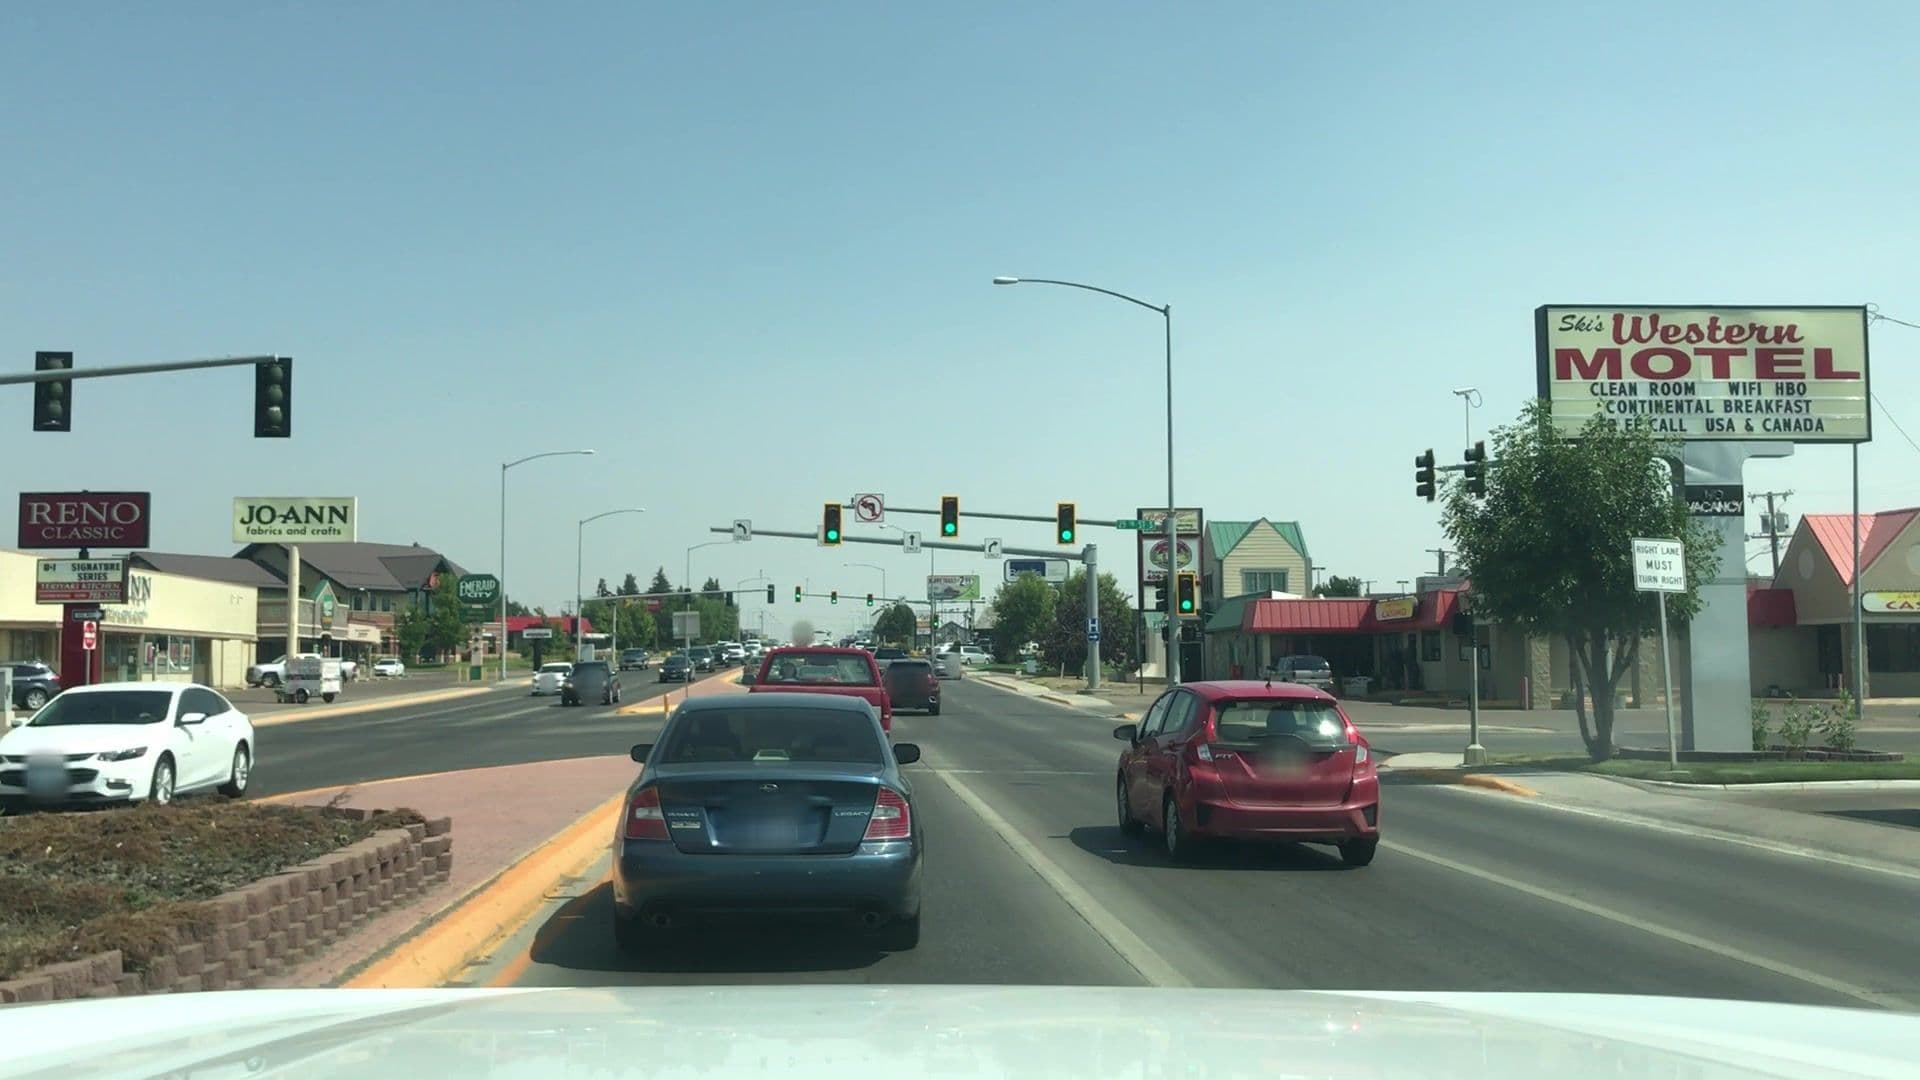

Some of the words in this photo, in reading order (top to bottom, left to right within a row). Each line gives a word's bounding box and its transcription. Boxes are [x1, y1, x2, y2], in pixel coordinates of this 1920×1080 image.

[1558, 314, 1604, 332] Ski's
[1612, 313, 1804, 345] Western
[1554, 347, 1861, 380] MOTEL
[1590, 382, 1637, 396] CLEAN
[1650, 382, 1696, 396] ROOM
[1728, 382, 1762, 396] WIFI
[1775, 382, 1807, 396] HBO
[1606, 400, 1714, 414] CONTINENTAL
[1723, 400, 1812, 414] BREAKFAST
[1650, 418, 1687, 432] CALL
[1706, 418, 1735, 432] USA
[1744, 418, 1754, 432] &
[1762, 418, 1825, 432] CANADA
[1687, 501, 1744, 513] VACANCY
[28, 502, 140, 525] RENO
[240, 505, 349, 525] JO-ANN
[41, 527, 124, 539] CLASSIC
[246, 526, 283, 536] fabrics
[286, 526, 307, 536] and
[311, 526, 342, 536] crafts
[1636, 545, 1658, 554] RIGHT
[1661, 546, 1681, 556] LANE
[71, 562, 120, 572] SIGNATURE
[1646, 560, 1673, 571] MUST
[77, 572, 108, 581] SERIES
[1639, 575, 1658, 584] TURN
[1661, 576, 1682, 585] RIGHT
[467, 591, 492, 599] CITY
